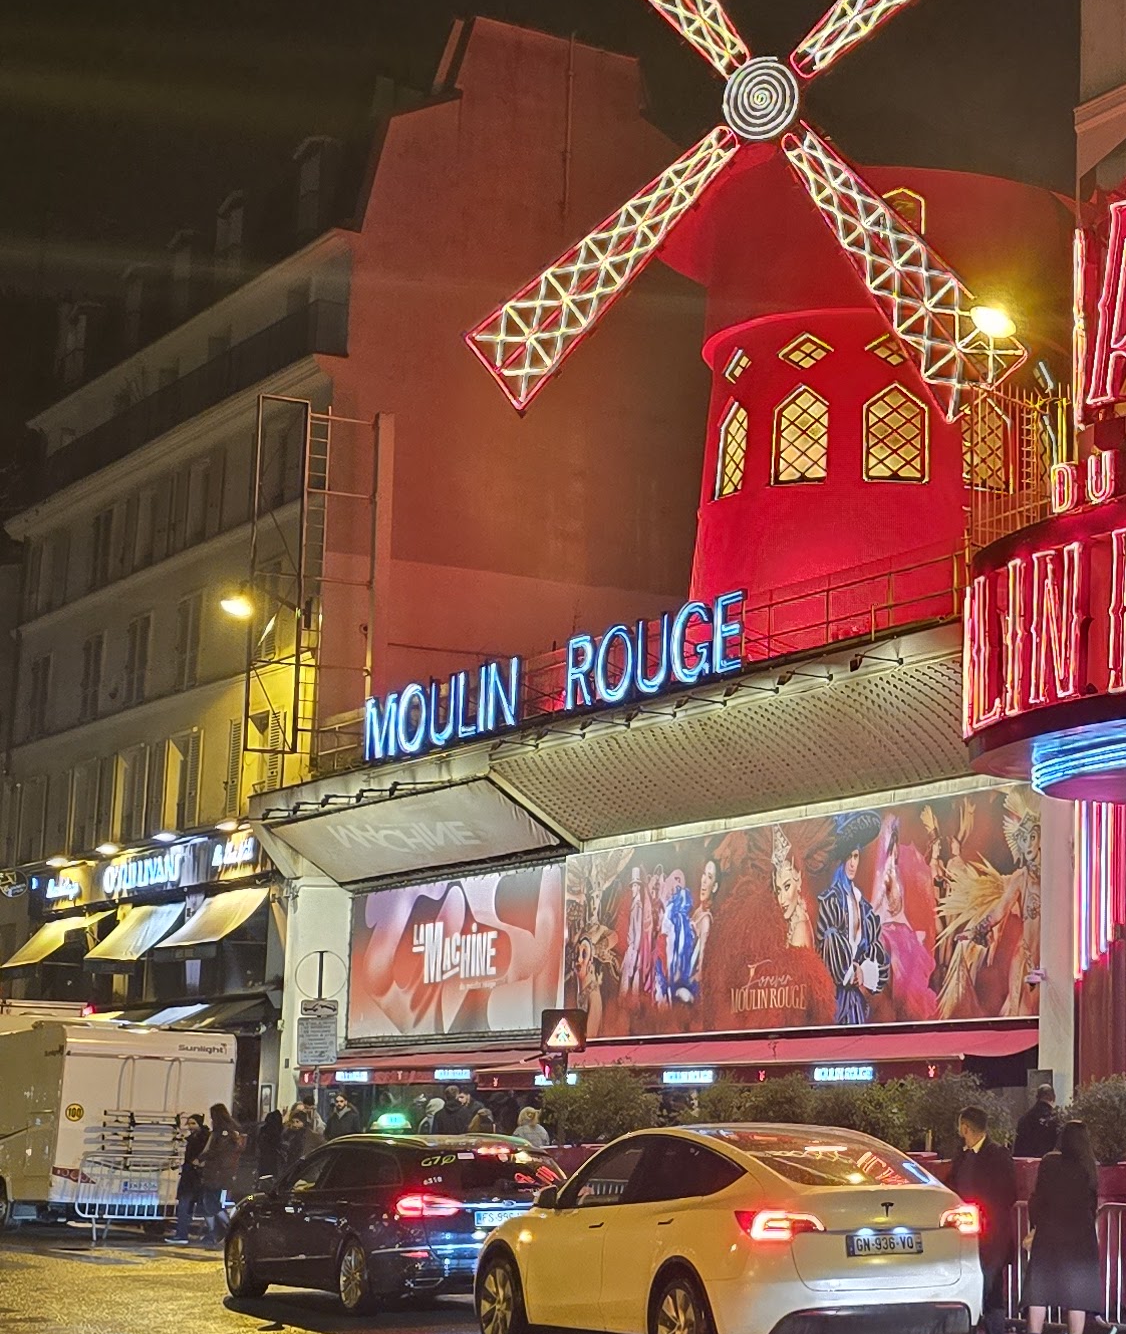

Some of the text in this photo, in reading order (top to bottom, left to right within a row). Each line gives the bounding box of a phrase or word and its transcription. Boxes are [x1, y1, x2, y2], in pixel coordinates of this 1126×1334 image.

[1051, 449, 1116, 514] DU
[963, 541, 1083, 738] LIN
[364, 588, 747, 761] MOULIN ROUGE
[412, 923, 425, 946] LA
[741, 959, 793, 988] Forever
[730, 983, 807, 1013] MOULIN ROUGE
[178, 1043, 224, 1055] Sunlight
[67, 1106, 82, 1118] 100
